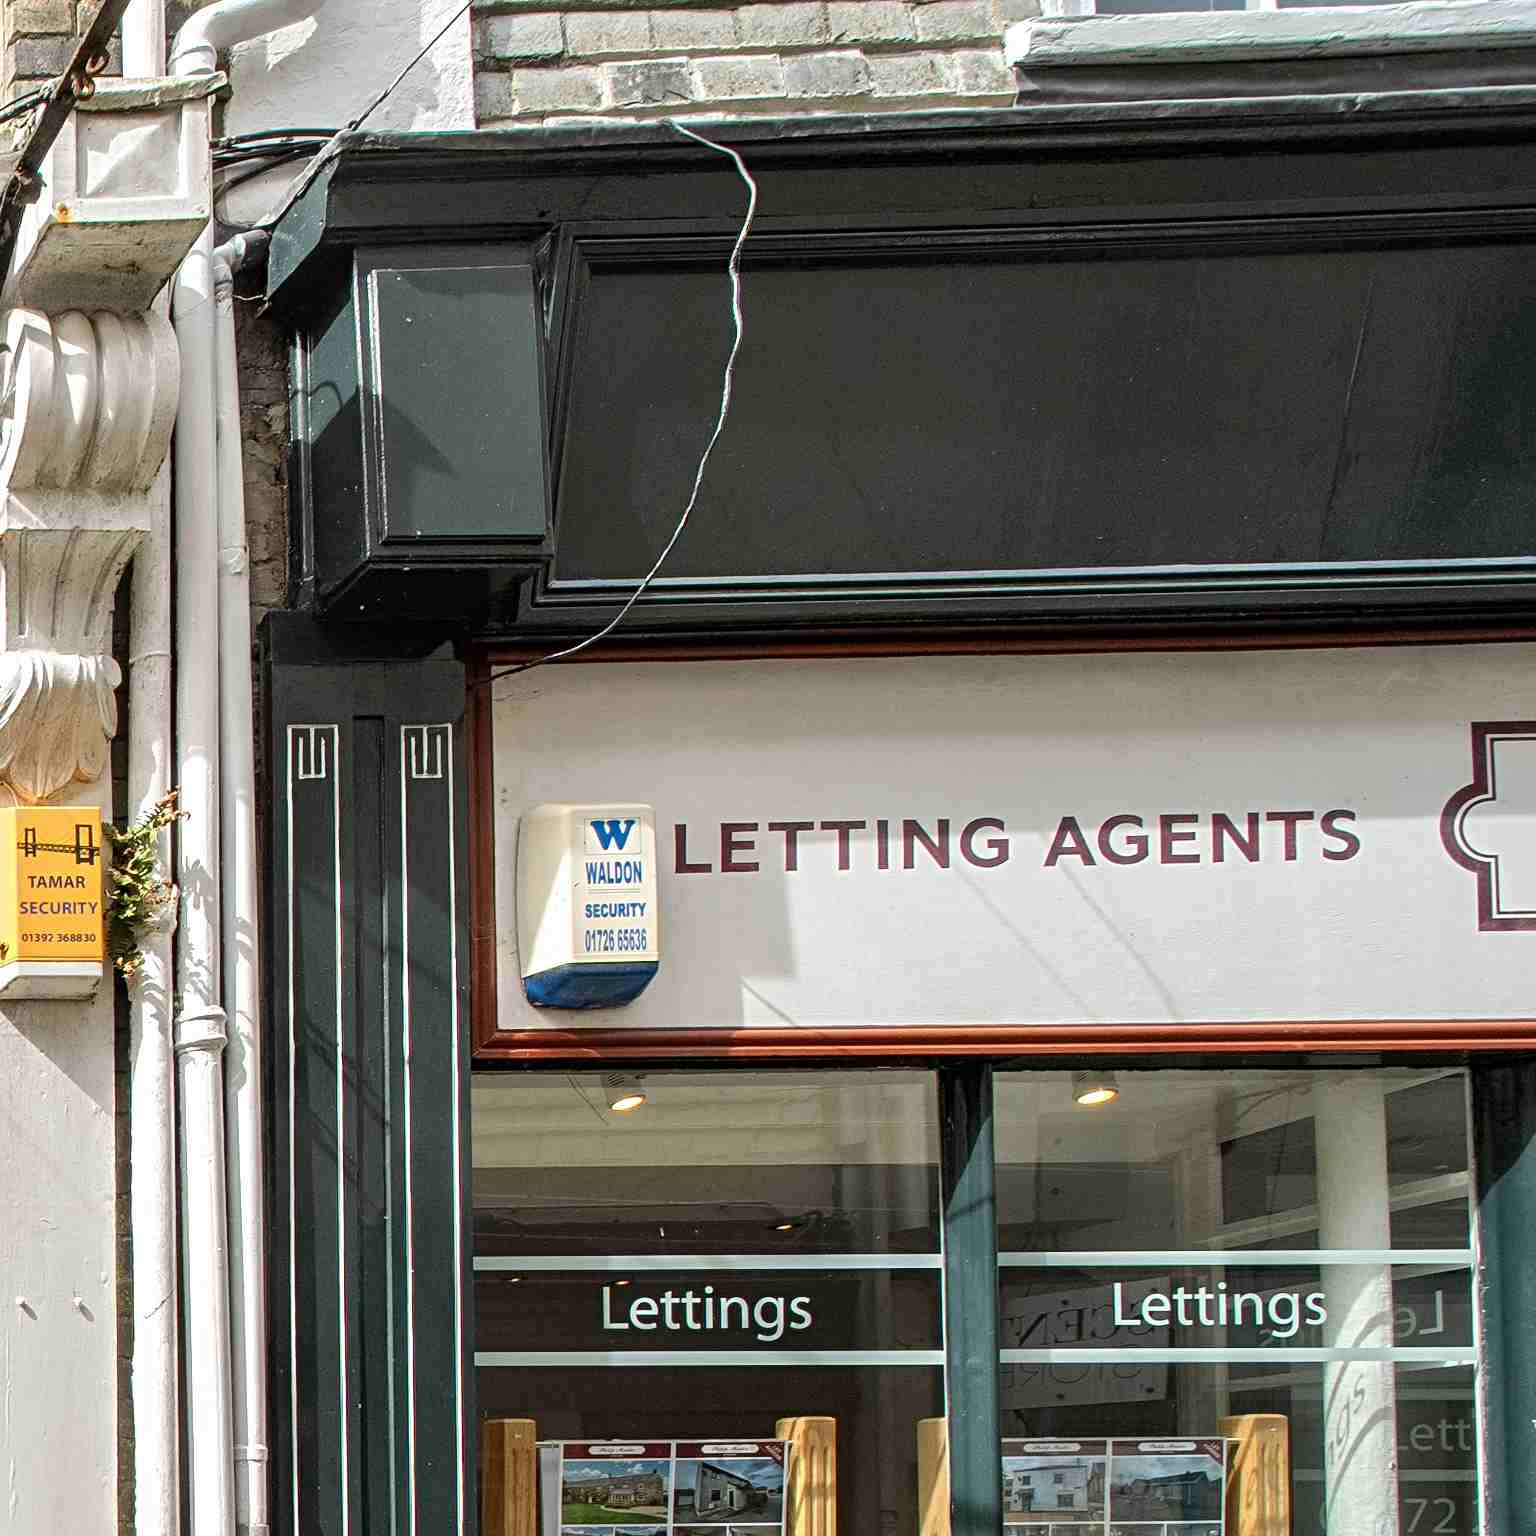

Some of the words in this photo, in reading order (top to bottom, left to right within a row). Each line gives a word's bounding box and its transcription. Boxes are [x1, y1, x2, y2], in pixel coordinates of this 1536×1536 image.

[590, 820, 635, 850] W
[674, 817, 1010, 874] LETTING
[1043, 808, 1362, 867] AGENTS
[28, 875, 86, 889] TAMAR
[585, 861, 642, 884] WALDON
[19, 901, 99, 914] SECURITY
[585, 902, 647, 918] SECURITY
[22, 933, 54, 943] 01392
[585, 929, 615, 952] 01726
[617, 928, 647, 951] 65636
[601, 1285, 812, 1341] Lettings
[1112, 1282, 1327, 1339] Lettings
